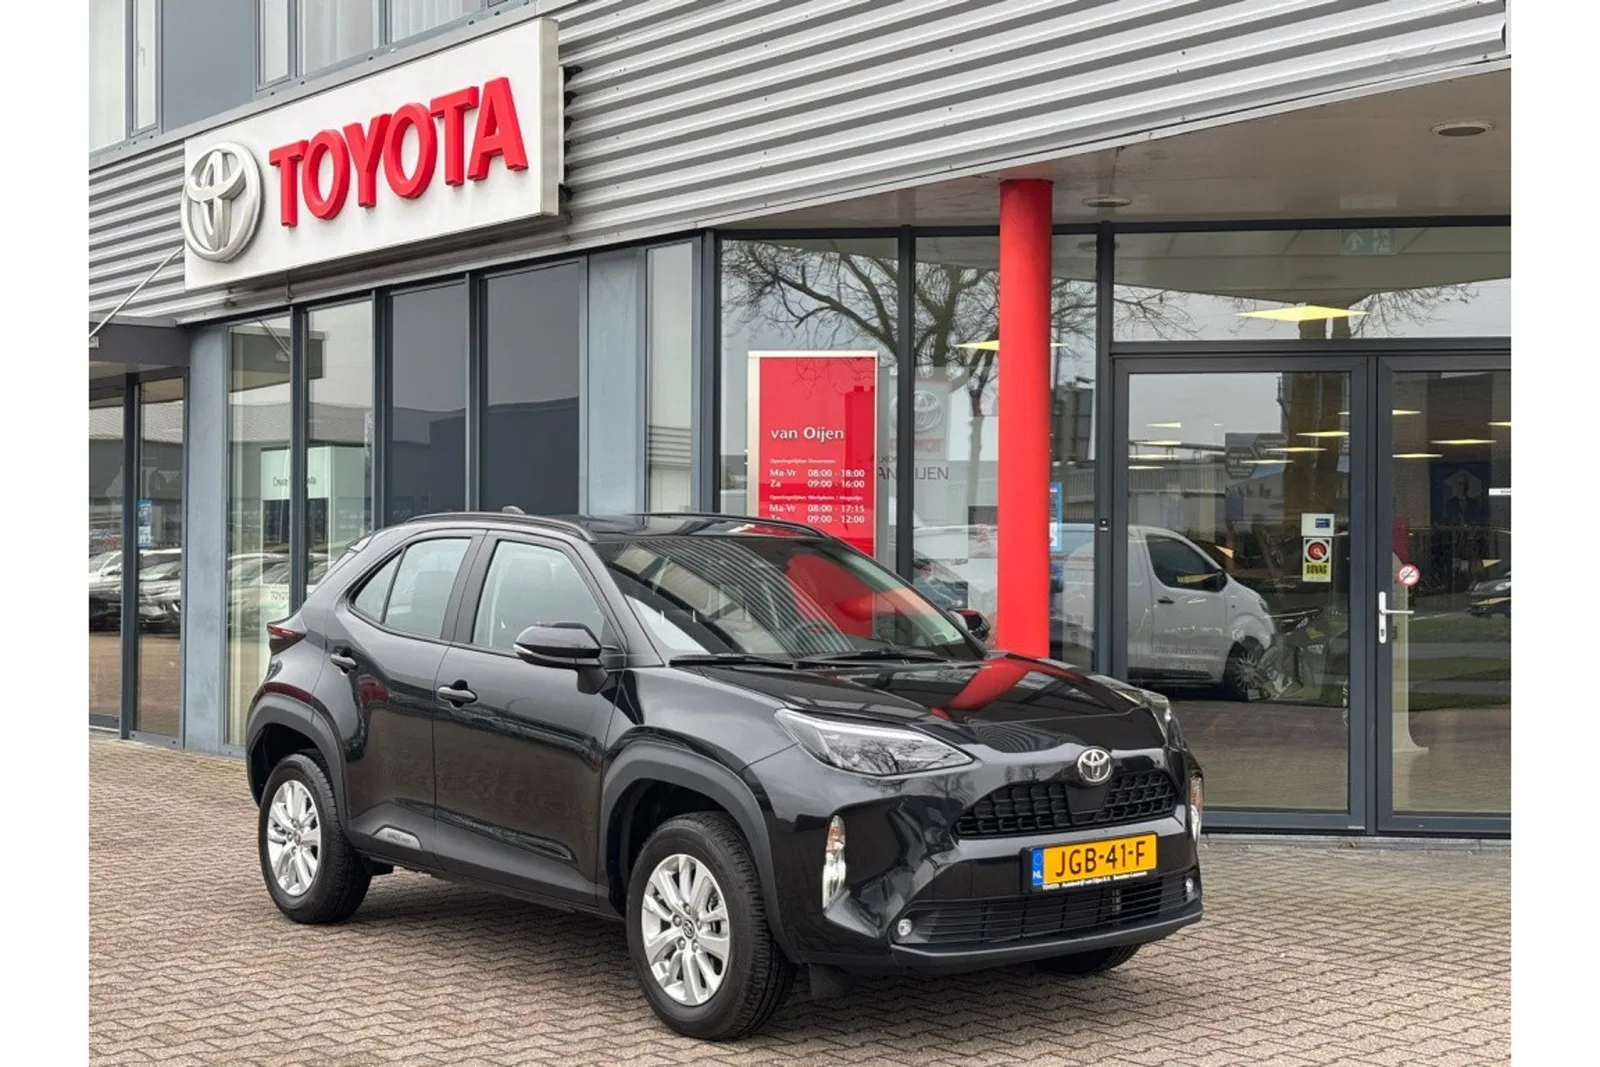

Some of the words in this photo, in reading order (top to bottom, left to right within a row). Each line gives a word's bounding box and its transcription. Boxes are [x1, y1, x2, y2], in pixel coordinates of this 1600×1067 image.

[268, 76, 529, 228] TOYOTA
[770, 429, 799, 440] van
[803, 426, 845, 443] Oijen
[770, 468, 796, 476] Ma-Vr
[808, 468, 832, 478] 08:00
[842, 468, 864, 478] 18:00
[769, 479, 782, 488] Za
[808, 480, 832, 488] 09:00
[842, 480, 864, 488] 16:00
[808, 504, 832, 512] 08:00
[842, 504, 864, 512] 17:15
[808, 514, 832, 524] 09:00
[842, 516, 864, 524] 12:00
[1306, 564, 1328, 574] BOVAG
[1032, 870, 1042, 878] NL
[1055, 840, 1147, 877] JGB-41-F
